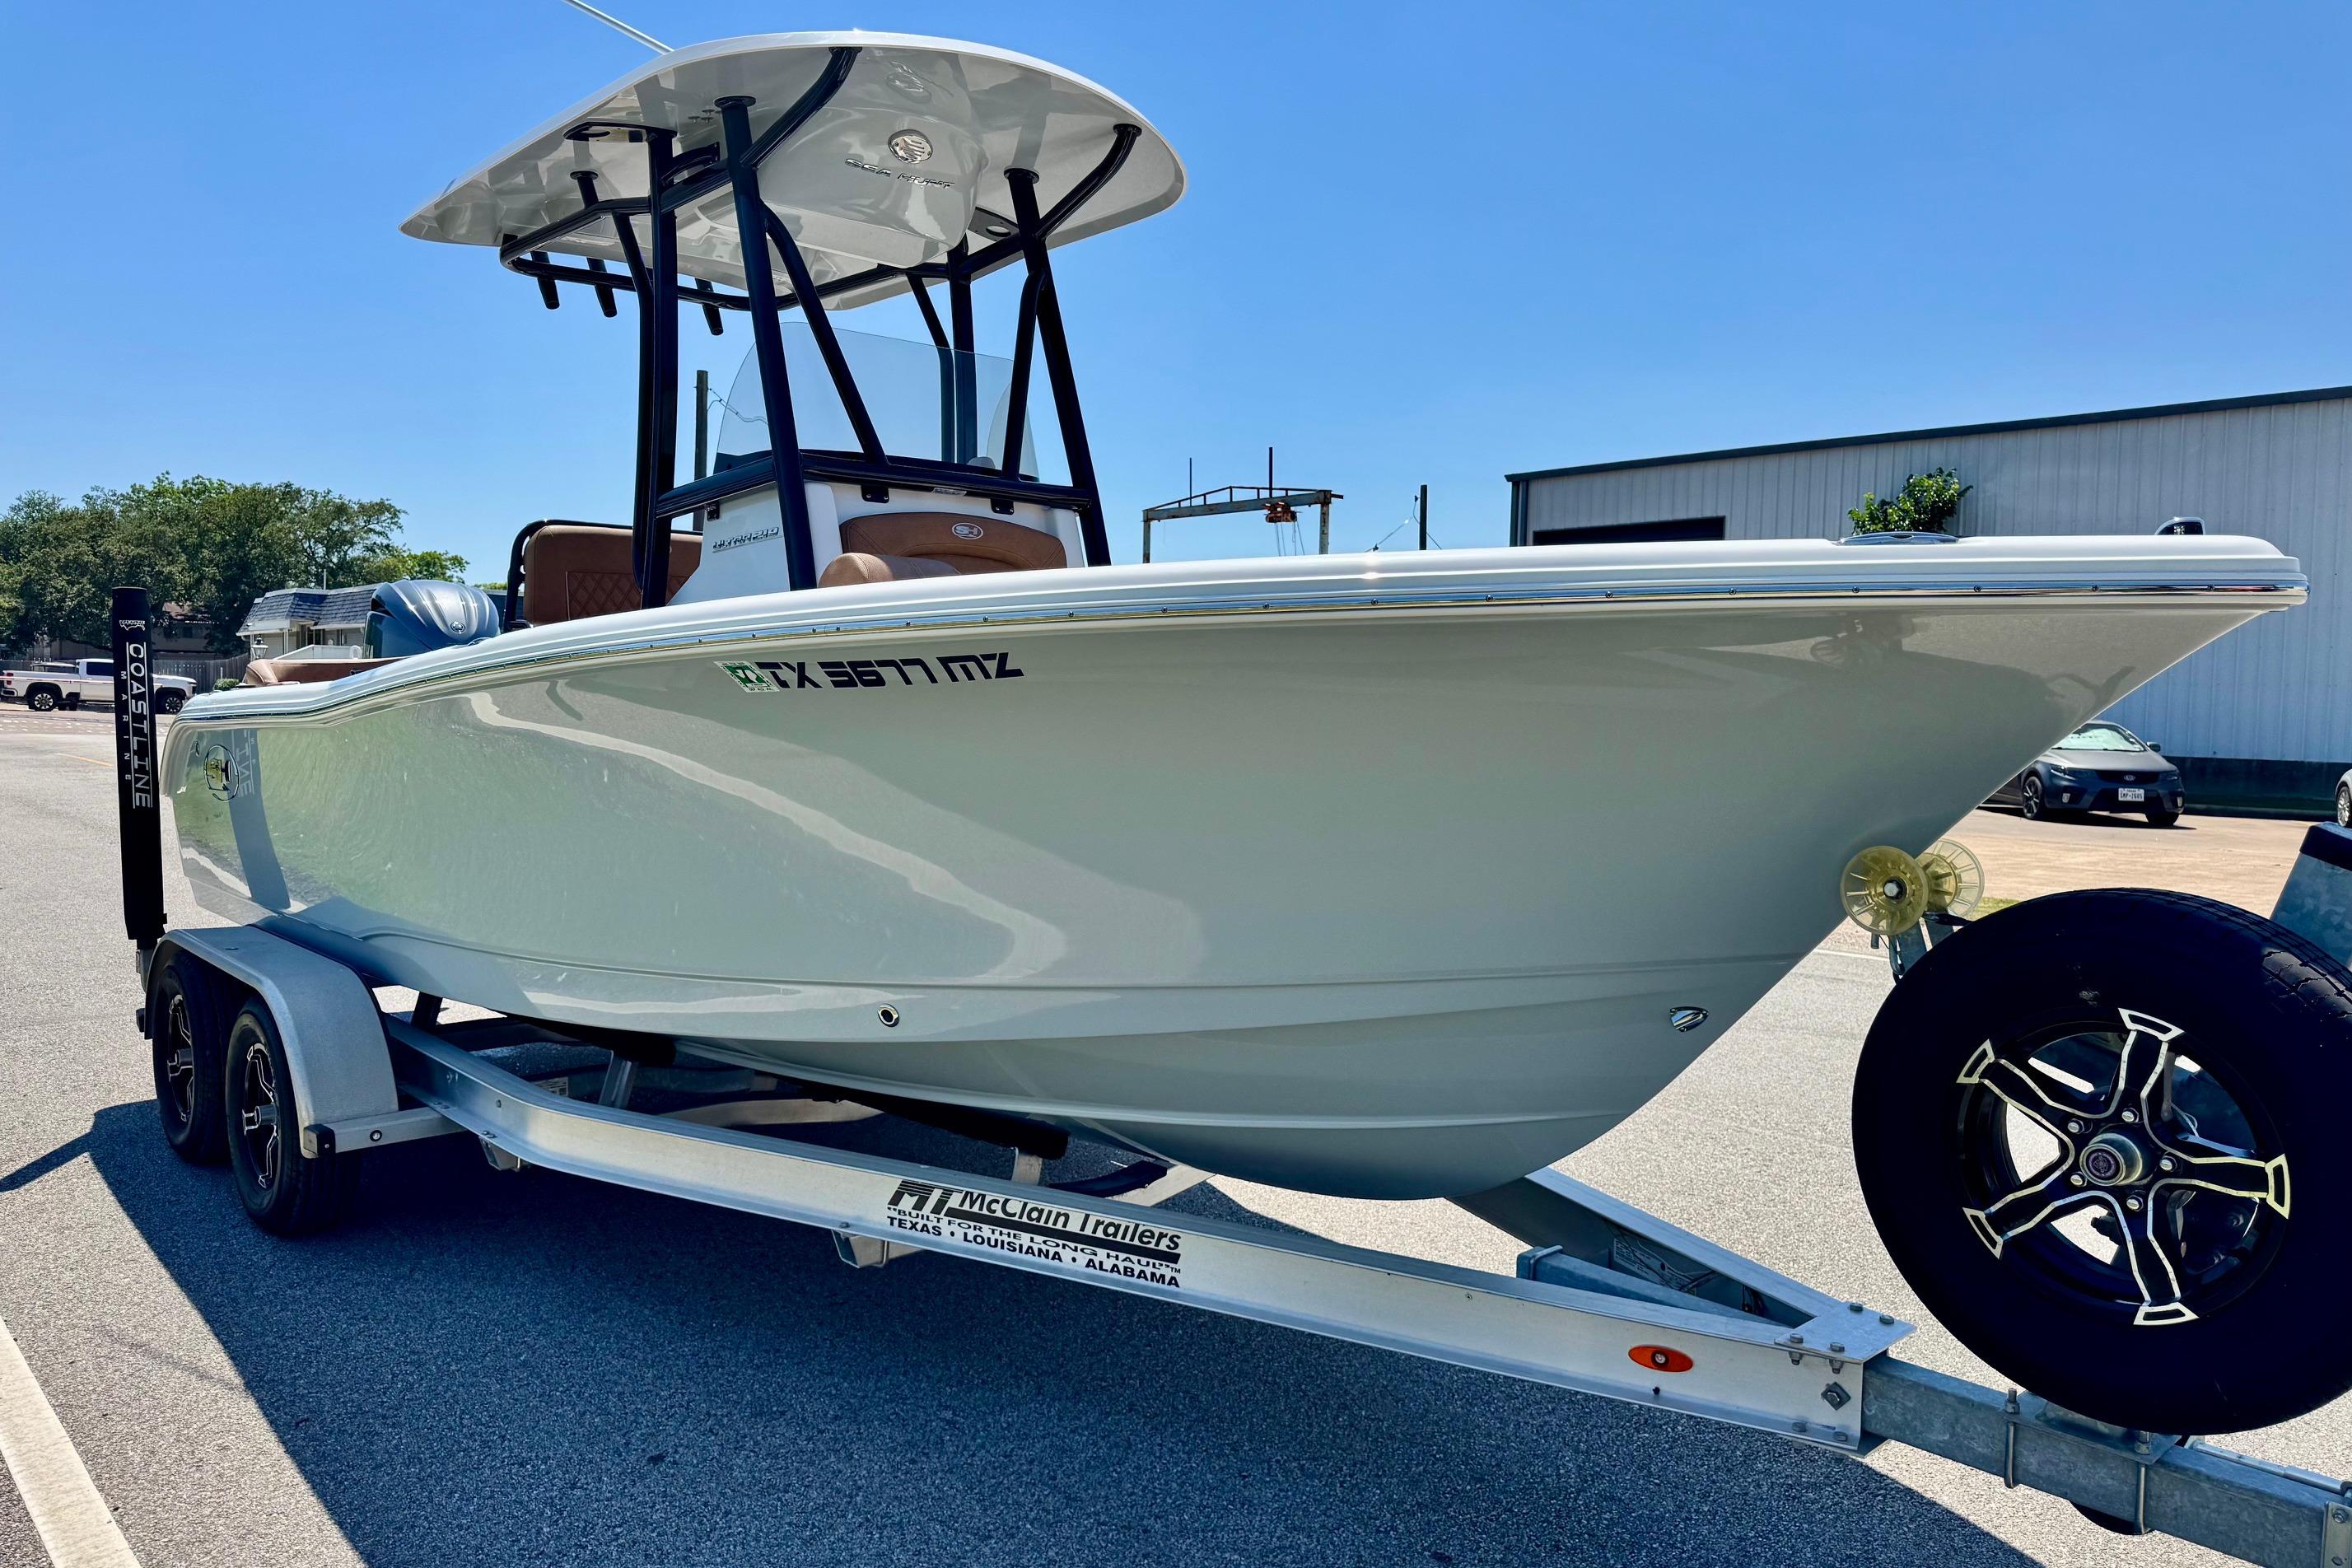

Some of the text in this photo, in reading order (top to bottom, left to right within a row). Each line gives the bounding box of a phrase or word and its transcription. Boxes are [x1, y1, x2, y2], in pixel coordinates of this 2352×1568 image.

[754, 661, 823, 688] TX
[936, 651, 1024, 683] MZ
[120, 670, 132, 780] MARINE
[129, 643, 151, 808] COASTLINE
[887, 1216, 1180, 1288] TEXAS LOUISIANA ALABAMA
[947, 1220, 983, 1233] FOR
[988, 1227, 1022, 1241] THE
[1029, 1236, 1098, 1257] LONG
[958, 1190, 1182, 1251] McClain Trailers
